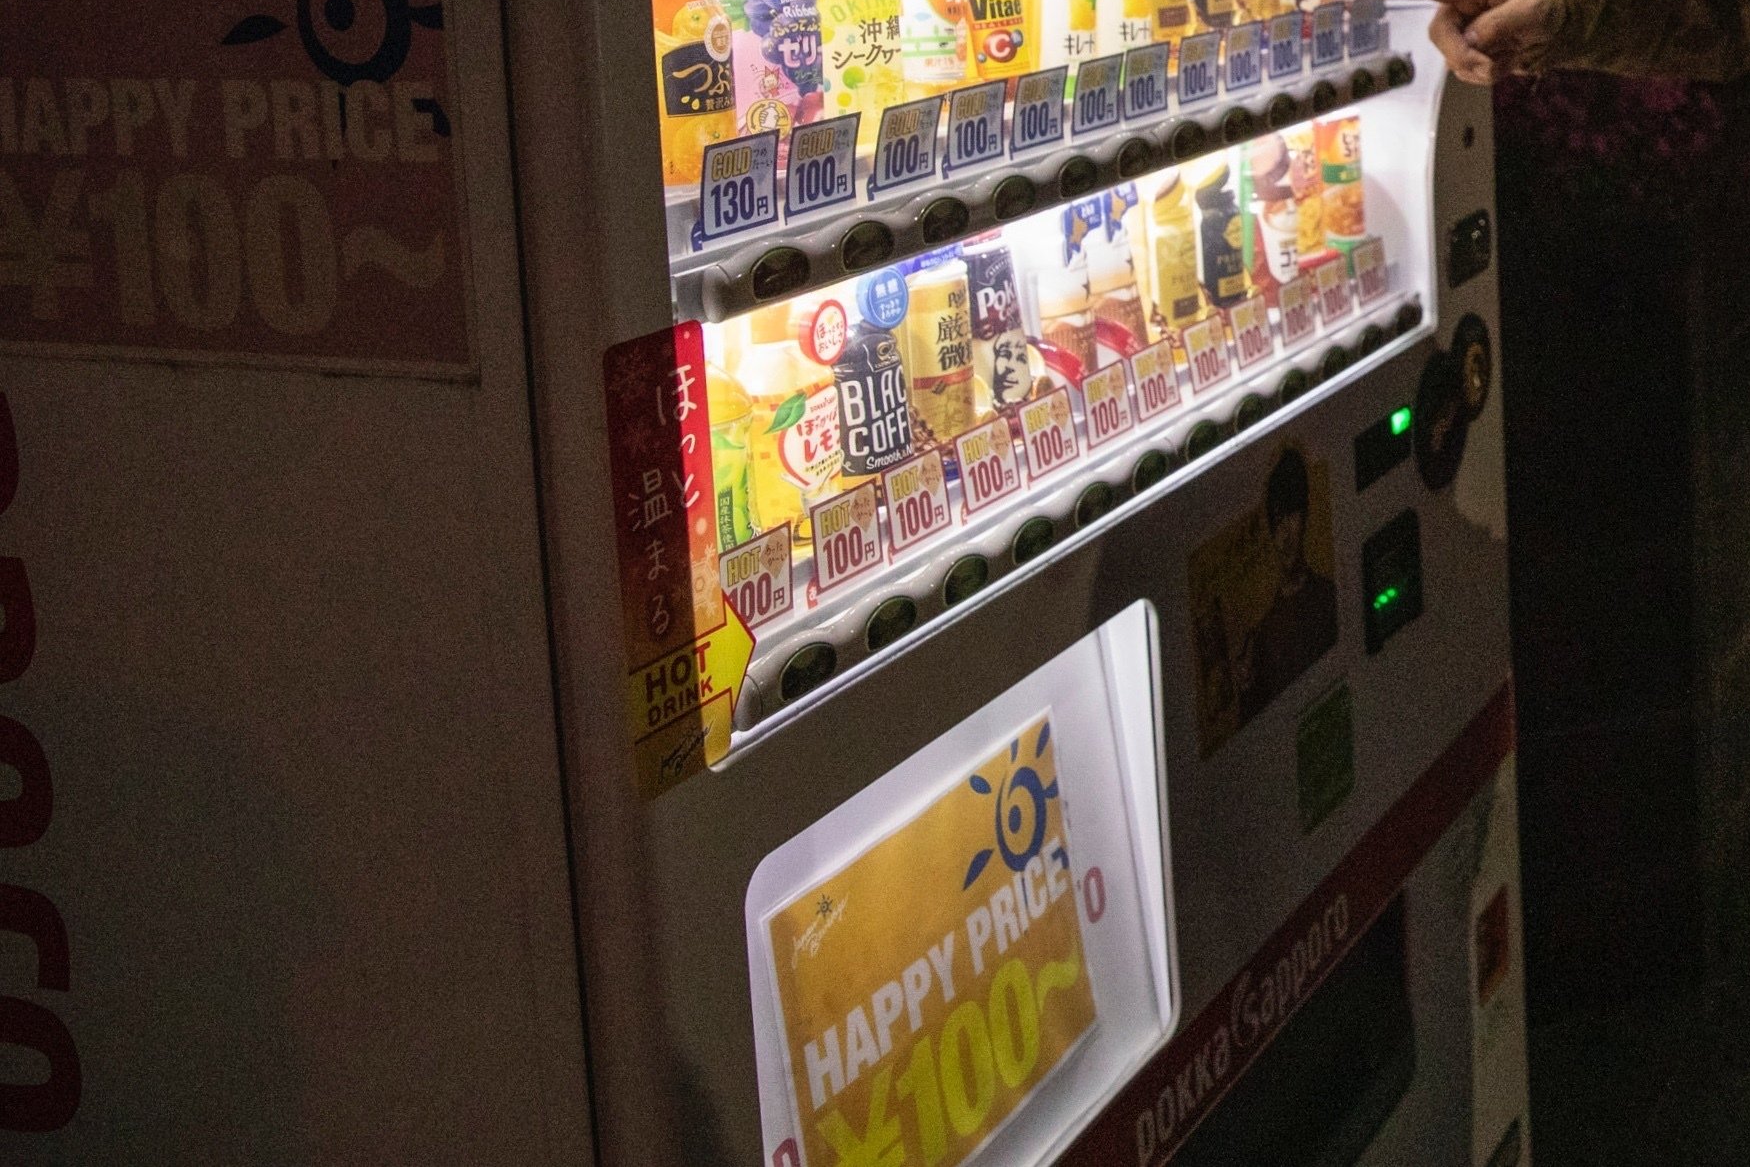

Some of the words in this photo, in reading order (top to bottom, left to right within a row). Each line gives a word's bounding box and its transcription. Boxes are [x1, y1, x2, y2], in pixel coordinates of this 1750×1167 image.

[222, 79, 440, 162] PRICE
[797, 127, 835, 160] GOLD
[954, 116, 997, 160] 100円
[711, 146, 752, 182] GOLD
[795, 155, 848, 205] 100円
[883, 134, 929, 181] 100円
[710, 177, 769, 229] 130円
[655, 363, 701, 510] ほっと
[962, 431, 990, 466] HOT
[1030, 424, 1073, 470] 100円
[891, 465, 919, 503] HOT
[968, 454, 1015, 503] 100円
[820, 503, 851, 539] HOT
[896, 489, 945, 541] 100円
[629, 466, 673, 637] 温まる
[727, 545, 761, 587] HOT
[822, 524, 876, 580] 100円
[645, 640, 713, 704] HOT
[647, 677, 714, 730] DRINK
[803, 933, 956, 1111] HAPPY
[965, 837, 1068, 978] PRICE
